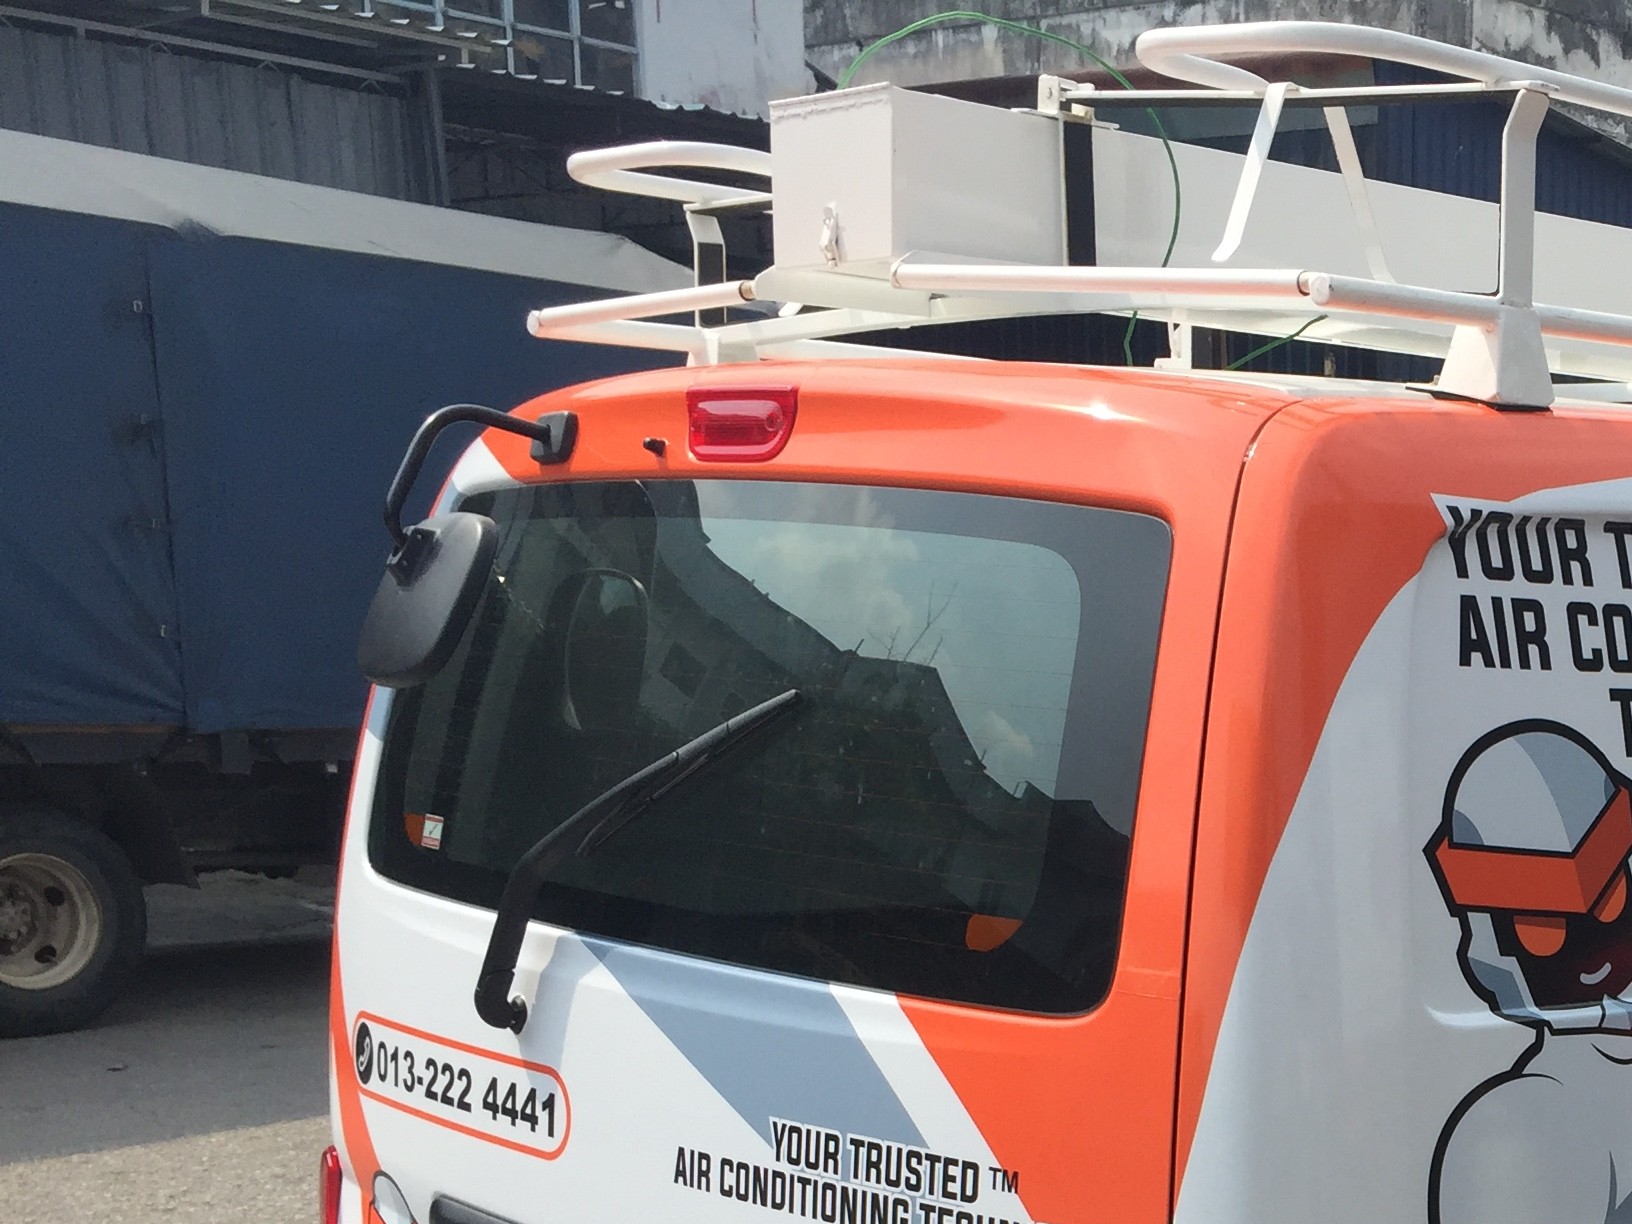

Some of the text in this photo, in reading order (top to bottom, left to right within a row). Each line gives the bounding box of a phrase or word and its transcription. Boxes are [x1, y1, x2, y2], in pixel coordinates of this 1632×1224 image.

[1446, 505, 1593, 587] YOUR
[1458, 594, 1552, 670] AIR
[376, 1040, 556, 1139] 013-222 4441
[673, 1146, 712, 1193] AIR
[772, 1120, 841, 1176] YOUR
[848, 1137, 980, 1204] TRUSTED
